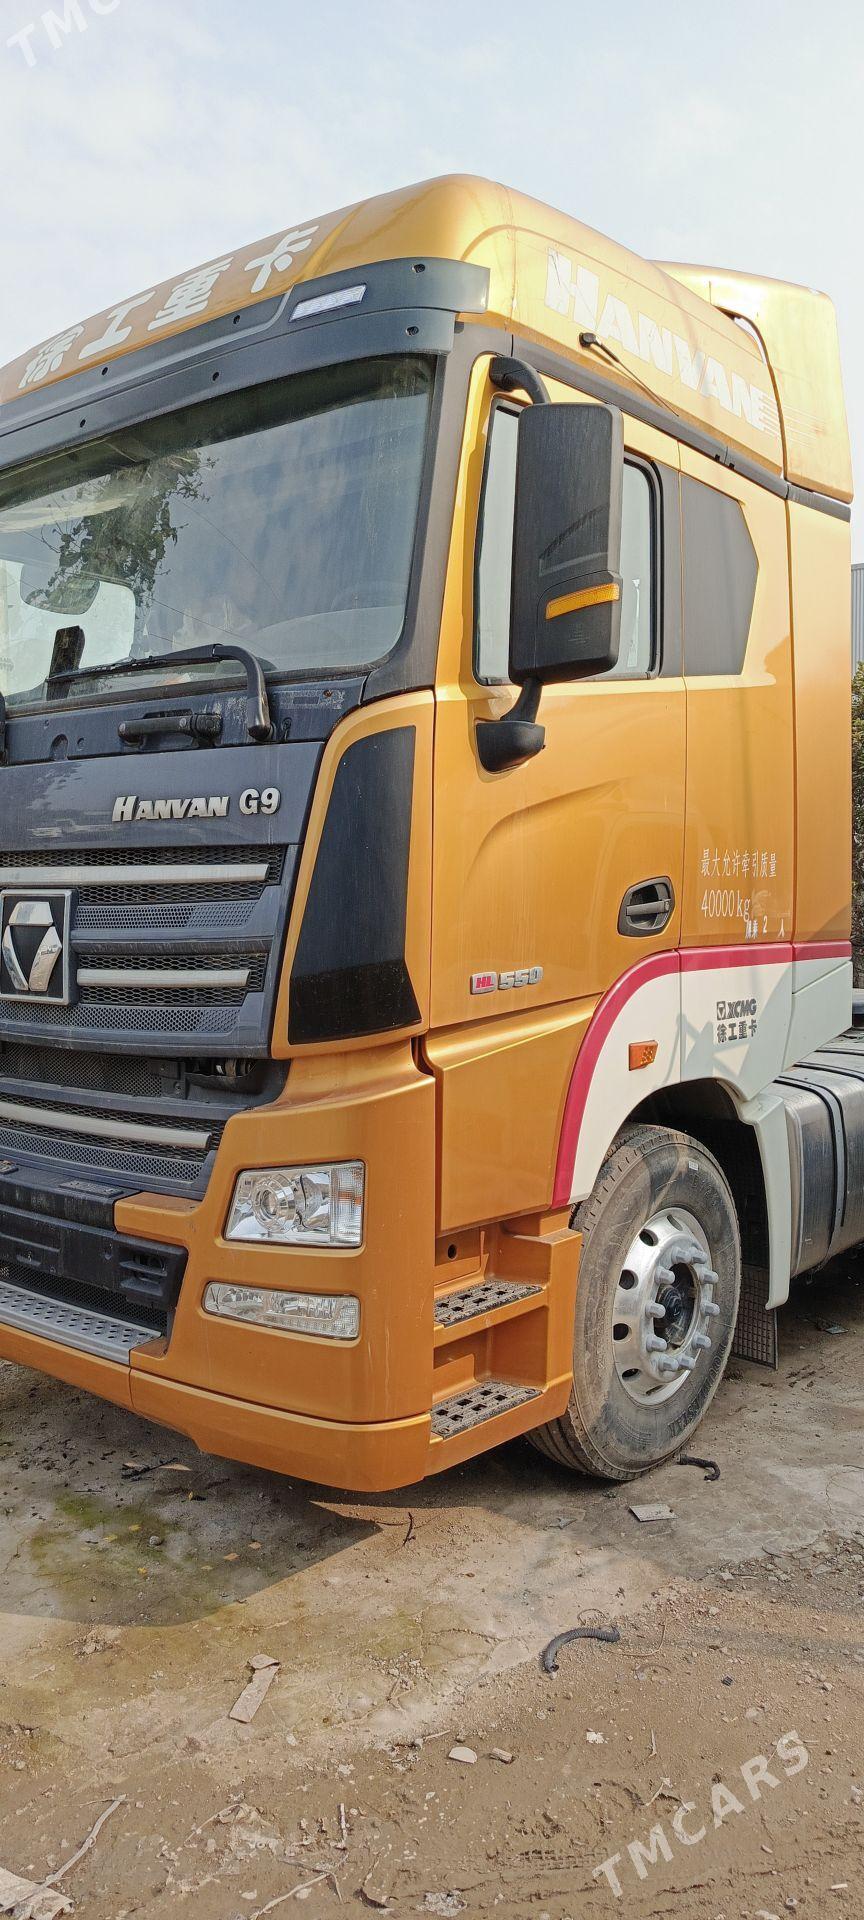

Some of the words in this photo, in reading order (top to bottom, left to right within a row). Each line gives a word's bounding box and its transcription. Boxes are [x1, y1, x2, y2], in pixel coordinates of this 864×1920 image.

[18, 225, 319, 389] 徐工重卡
[544, 247, 768, 432] HANVAN
[112, 795, 230, 822] HANVAN
[239, 787, 282, 816] G9
[701, 848, 777, 878] 最大允许牵引质量
[499, 966, 544, 990] 550
[727, 998, 757, 1019] XCMG
[716, 1019, 758, 1043] 徐工重卡
